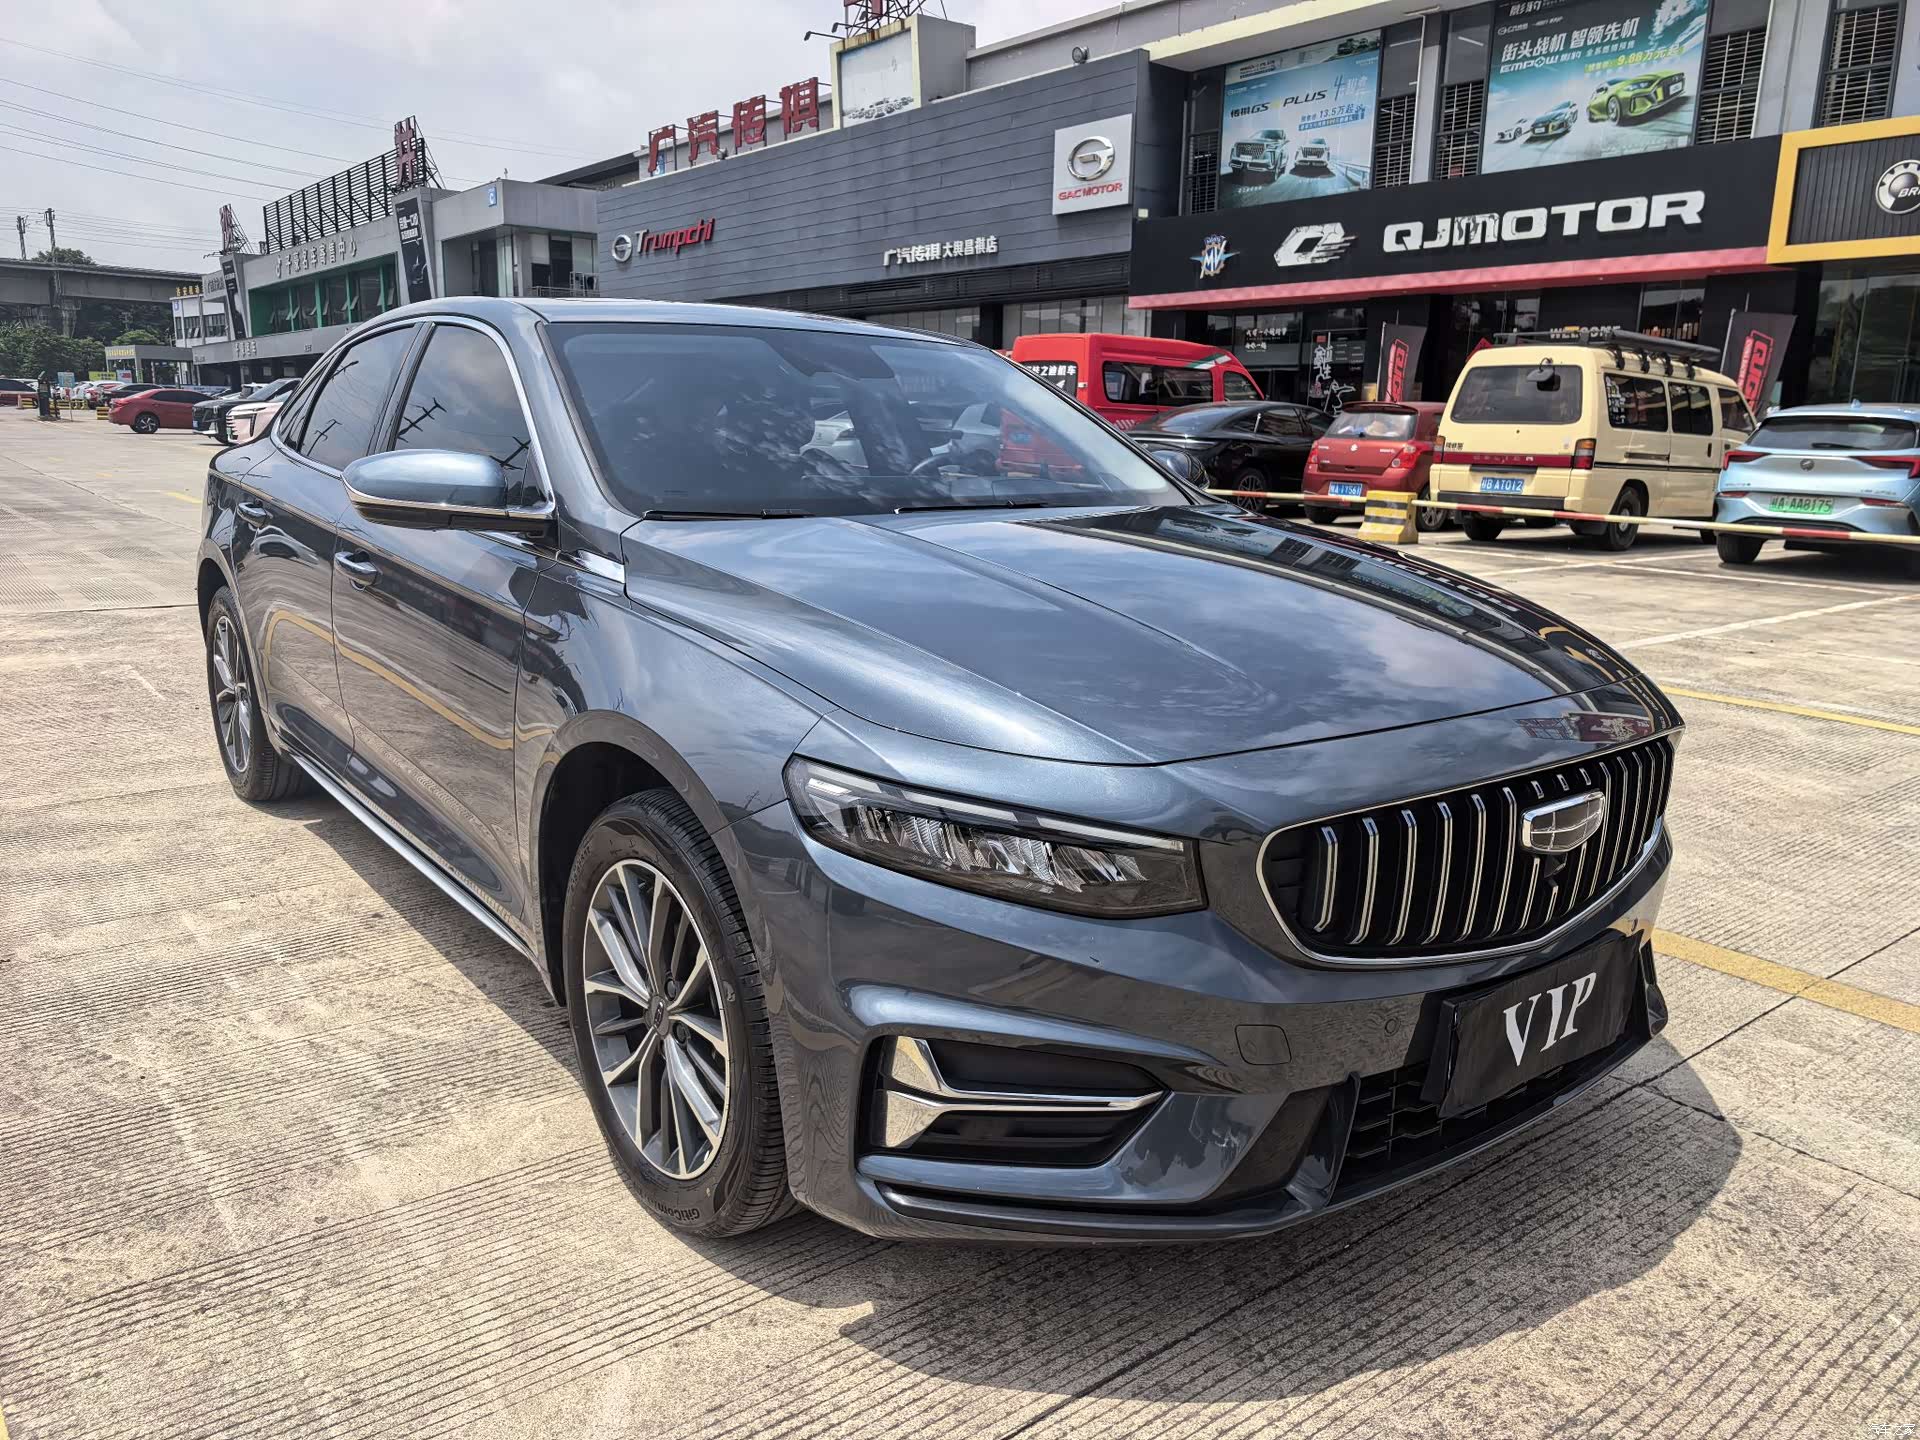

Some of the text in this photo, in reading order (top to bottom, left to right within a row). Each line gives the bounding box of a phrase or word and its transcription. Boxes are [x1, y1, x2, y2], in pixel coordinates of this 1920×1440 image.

[1501, 17, 1641, 62] 街头战机 智领先机
[1283, 90, 1328, 108] PLUS
[648, 77, 818, 173] 广汽传祺
[1058, 182, 1123, 200] GAC MOTOR
[1898, 186, 1920, 198] BR
[634, 217, 715, 256] Trumpchi
[1382, 190, 1706, 253] QJMOTOR
[883, 242, 941, 266] 广汽传祺
[1503, 972, 1597, 1067] VIP
